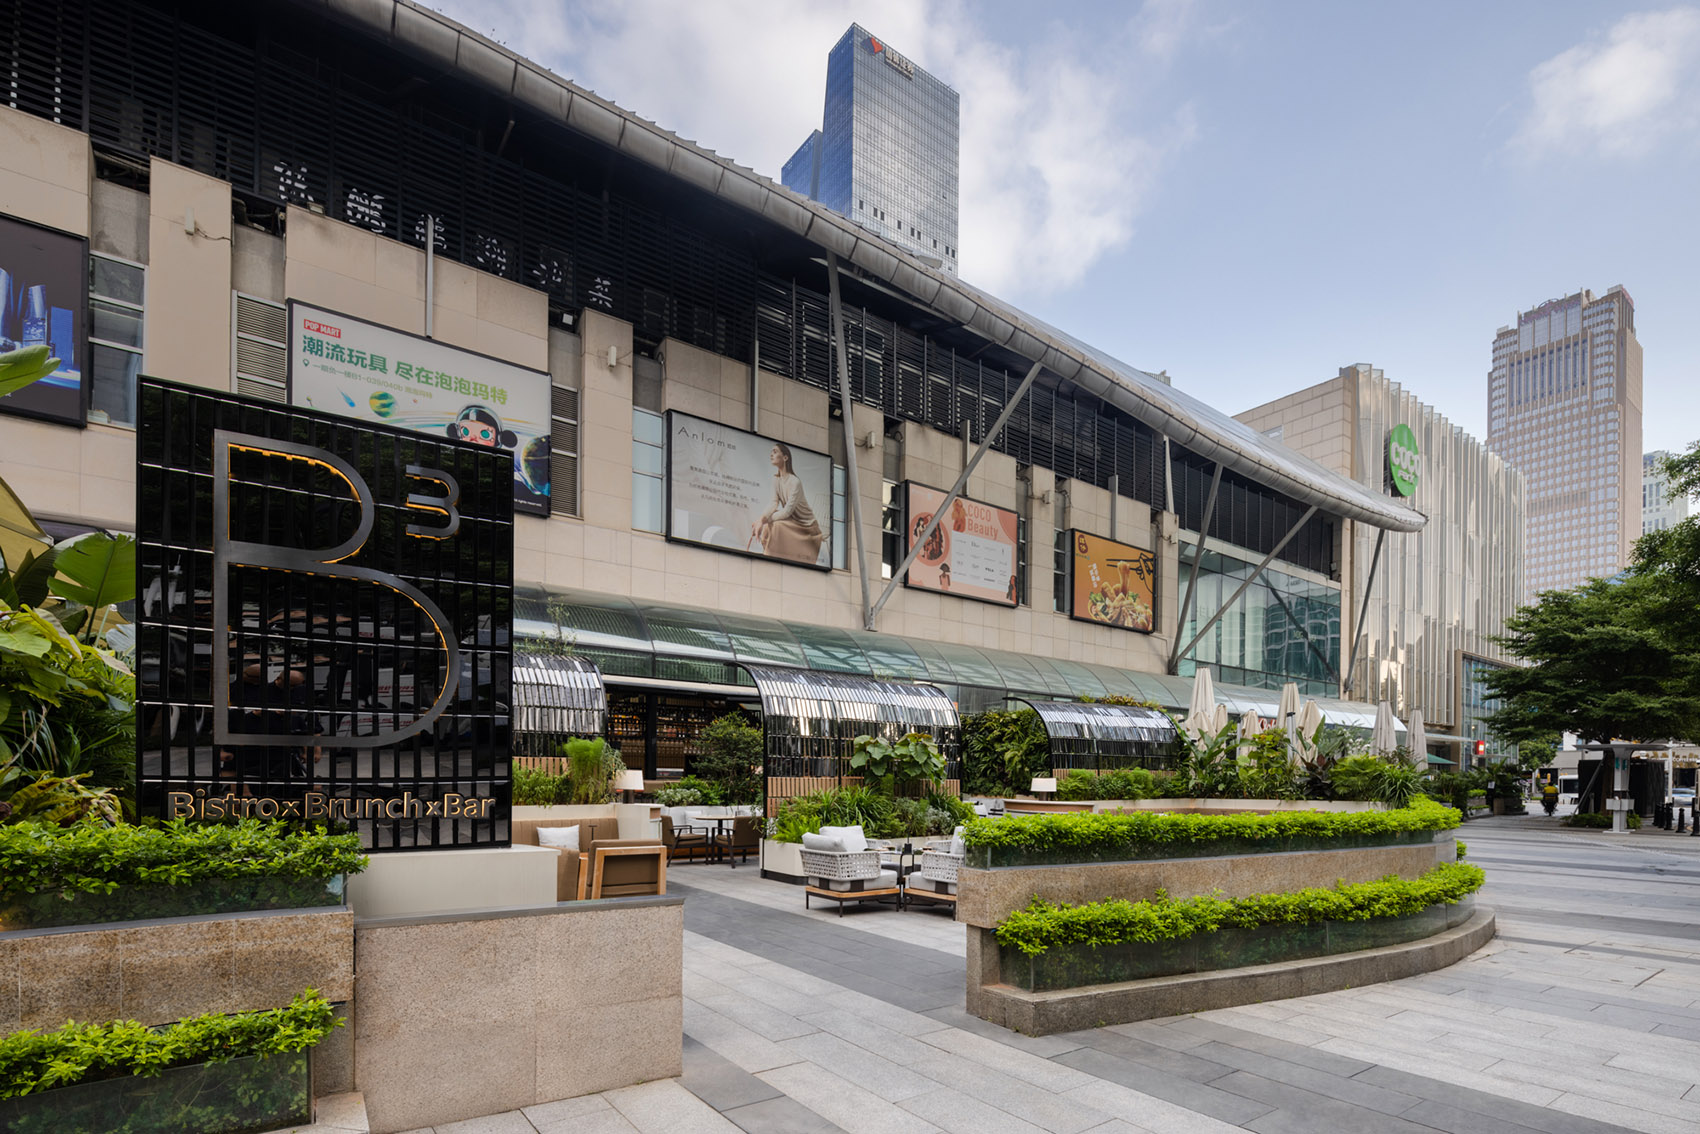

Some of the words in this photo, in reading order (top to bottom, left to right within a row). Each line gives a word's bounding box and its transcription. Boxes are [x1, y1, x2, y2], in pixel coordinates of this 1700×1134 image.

[305, 320, 319, 331] POP
[320, 324, 340, 337] MART
[302, 334, 389, 375] 潮流玩具
[395, 360, 509, 405] 尽在泡泡玛特
[678, 426, 726, 447] Anlom
[968, 504, 991, 522] COCO
[968, 519, 999, 540] Beauty
